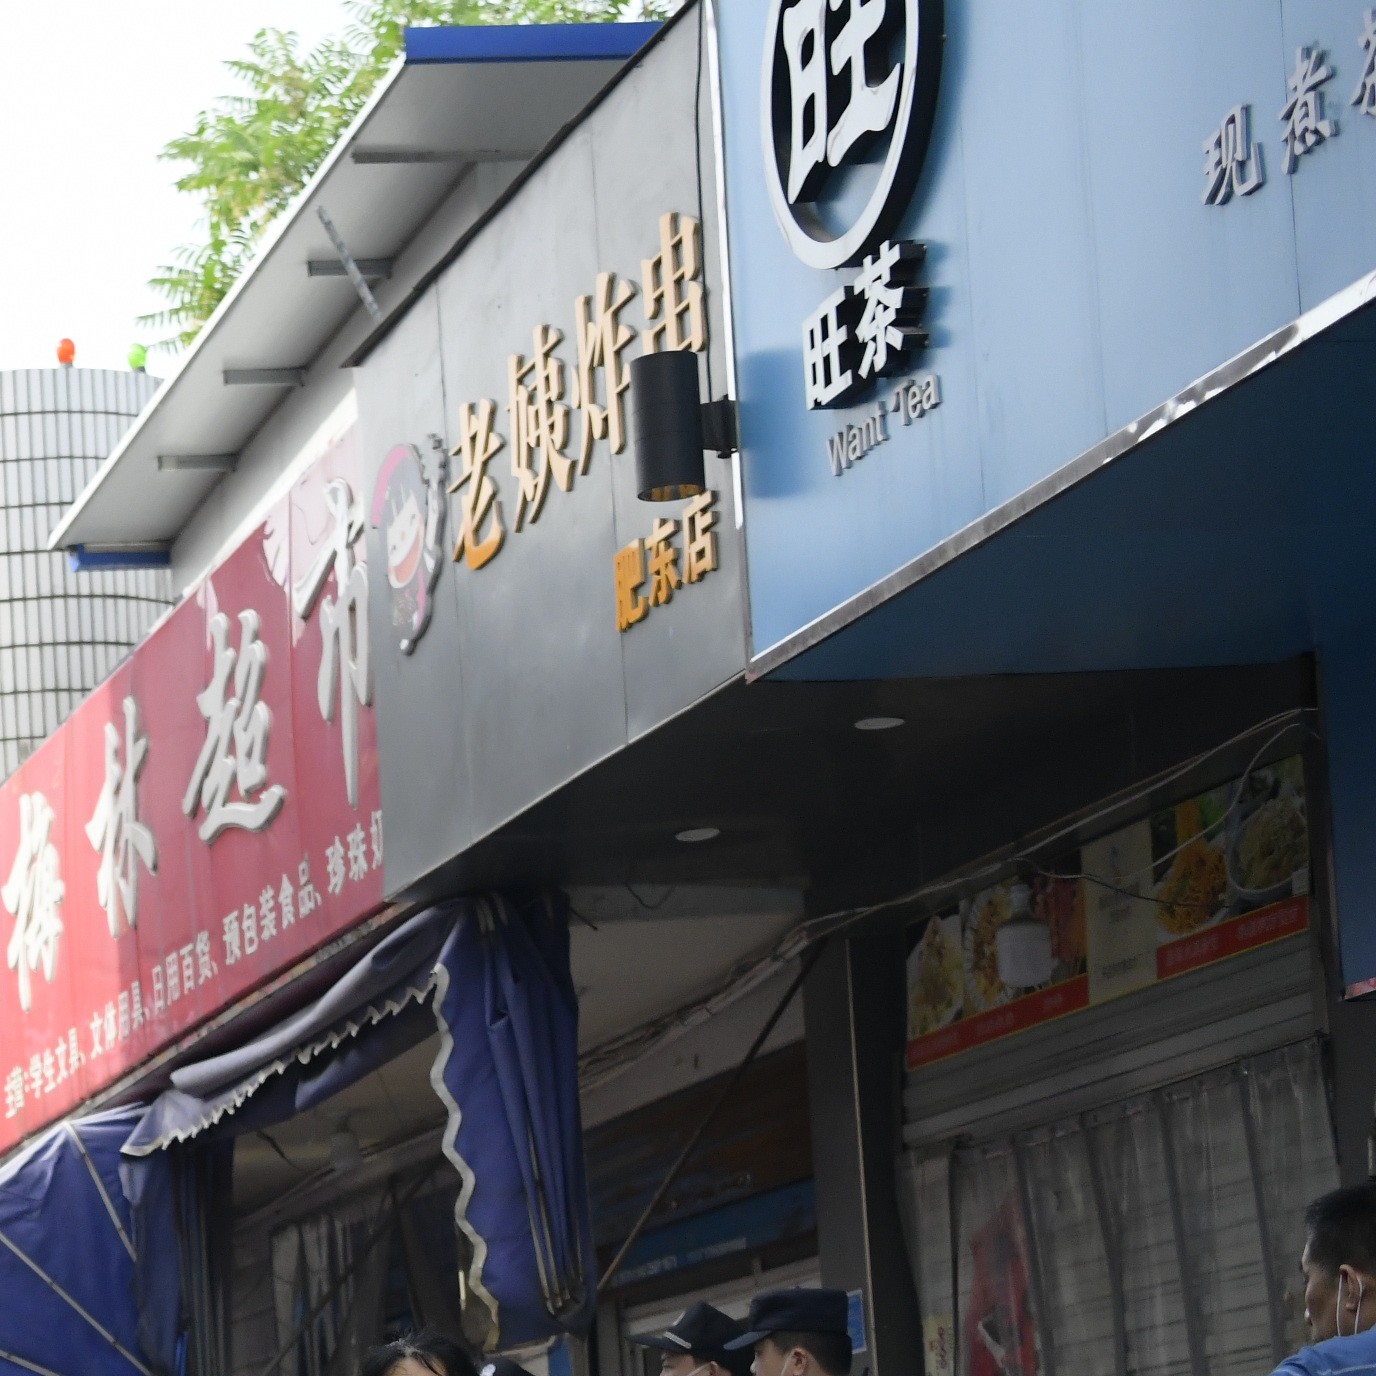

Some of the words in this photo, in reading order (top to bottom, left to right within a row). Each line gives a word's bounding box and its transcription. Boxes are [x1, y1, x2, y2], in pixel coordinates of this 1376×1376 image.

[802, 240, 906, 411] 旺茶
[826, 401, 887, 477] Want
[890, 372, 941, 427] Tea
[614, 490, 718, 633] 肥东店
